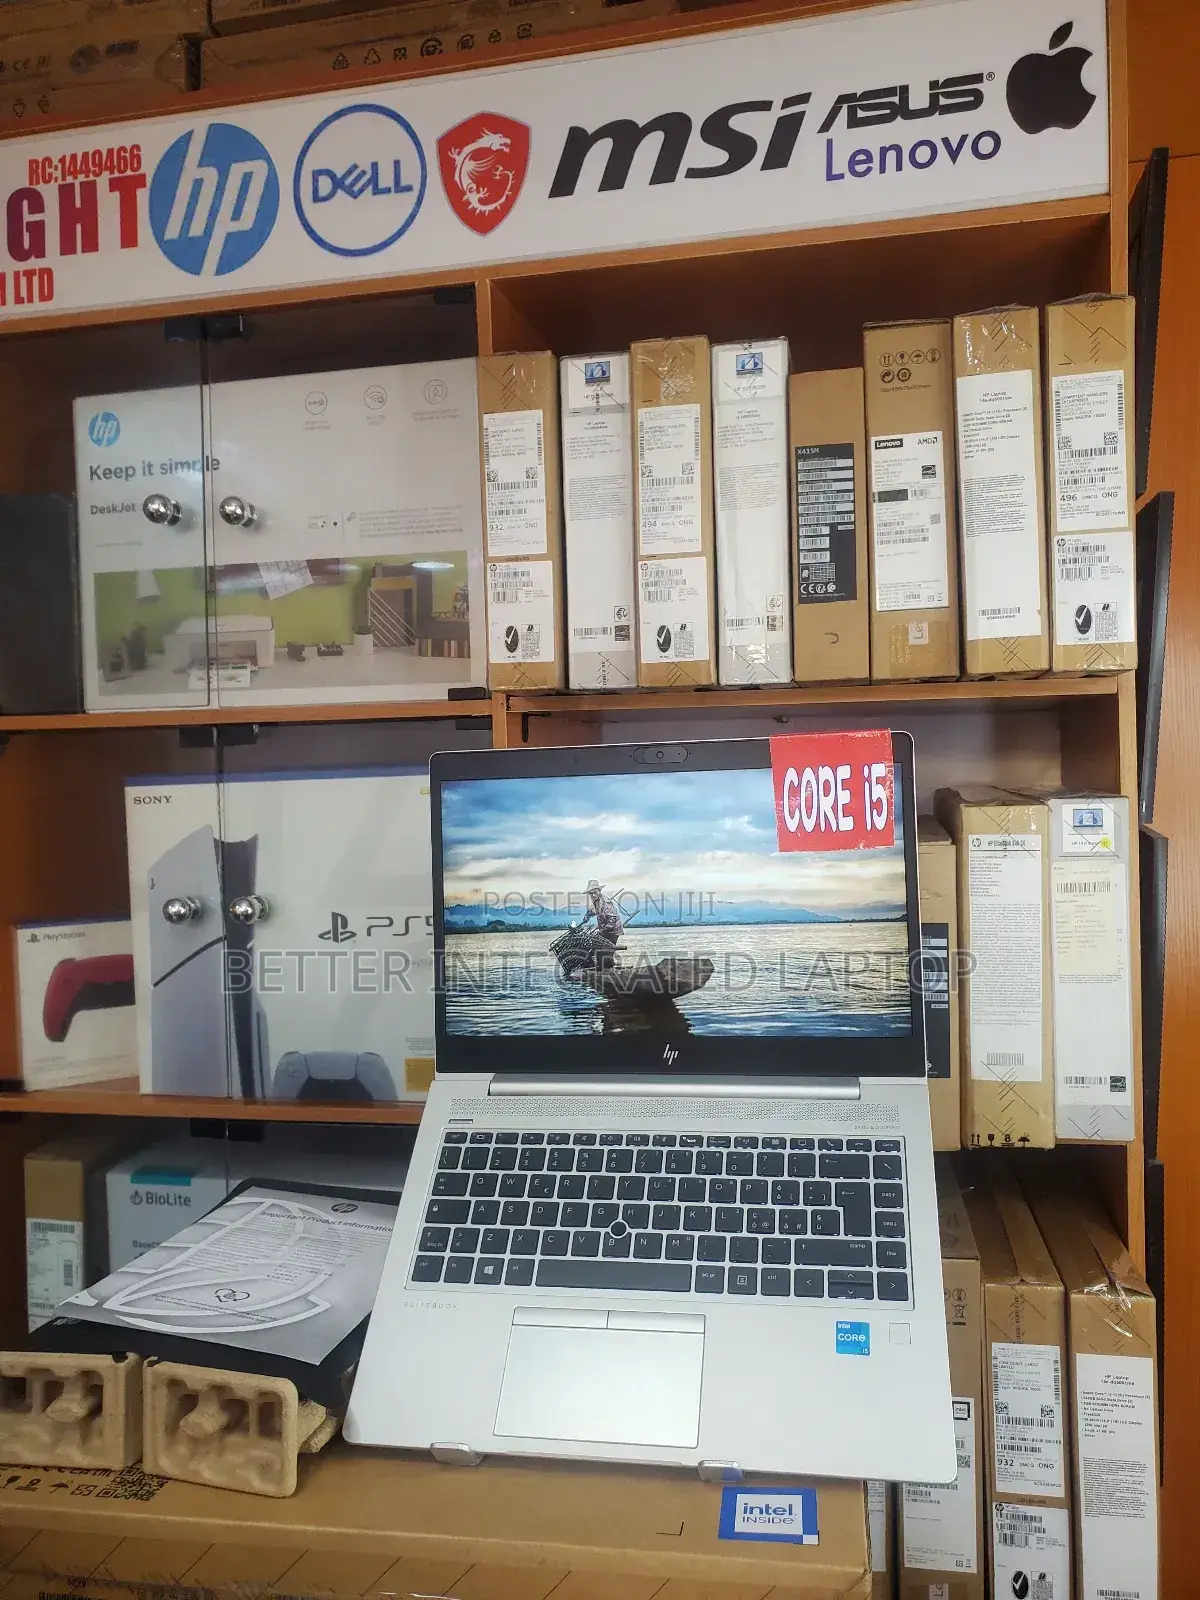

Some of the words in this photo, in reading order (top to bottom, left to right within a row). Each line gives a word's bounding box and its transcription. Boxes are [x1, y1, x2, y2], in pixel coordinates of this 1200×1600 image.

[548, 91, 812, 199] msi
[28, 144, 142, 186] RC:1449466
[825, 130, 1002, 182] Lenovo
[312, 158, 413, 203] DELL
[154, 123, 276, 276] hp
[13, 267, 54, 305] LTD
[88, 411, 121, 447] hp
[876, 439, 902, 449] Lenovo
[917, 438, 932, 446] AMD
[89, 464, 137, 482] Keep
[142, 460, 154, 476] it
[1060, 494, 1078, 502] 496
[90, 502, 136, 515] DeskJet
[489, 524, 504, 532] 932
[133, 795, 173, 805] SONY
[782, 766, 853, 833] CORE
[863, 762, 888, 832] i5
[366, 915, 433, 937] PS
[145, 1192, 191, 1206] BioLite
[260, 1211, 306, 1221] Important
[307, 1216, 342, 1226] Product
[997, 1458, 1014, 1466] 932
[742, 1503, 793, 1516] intel
